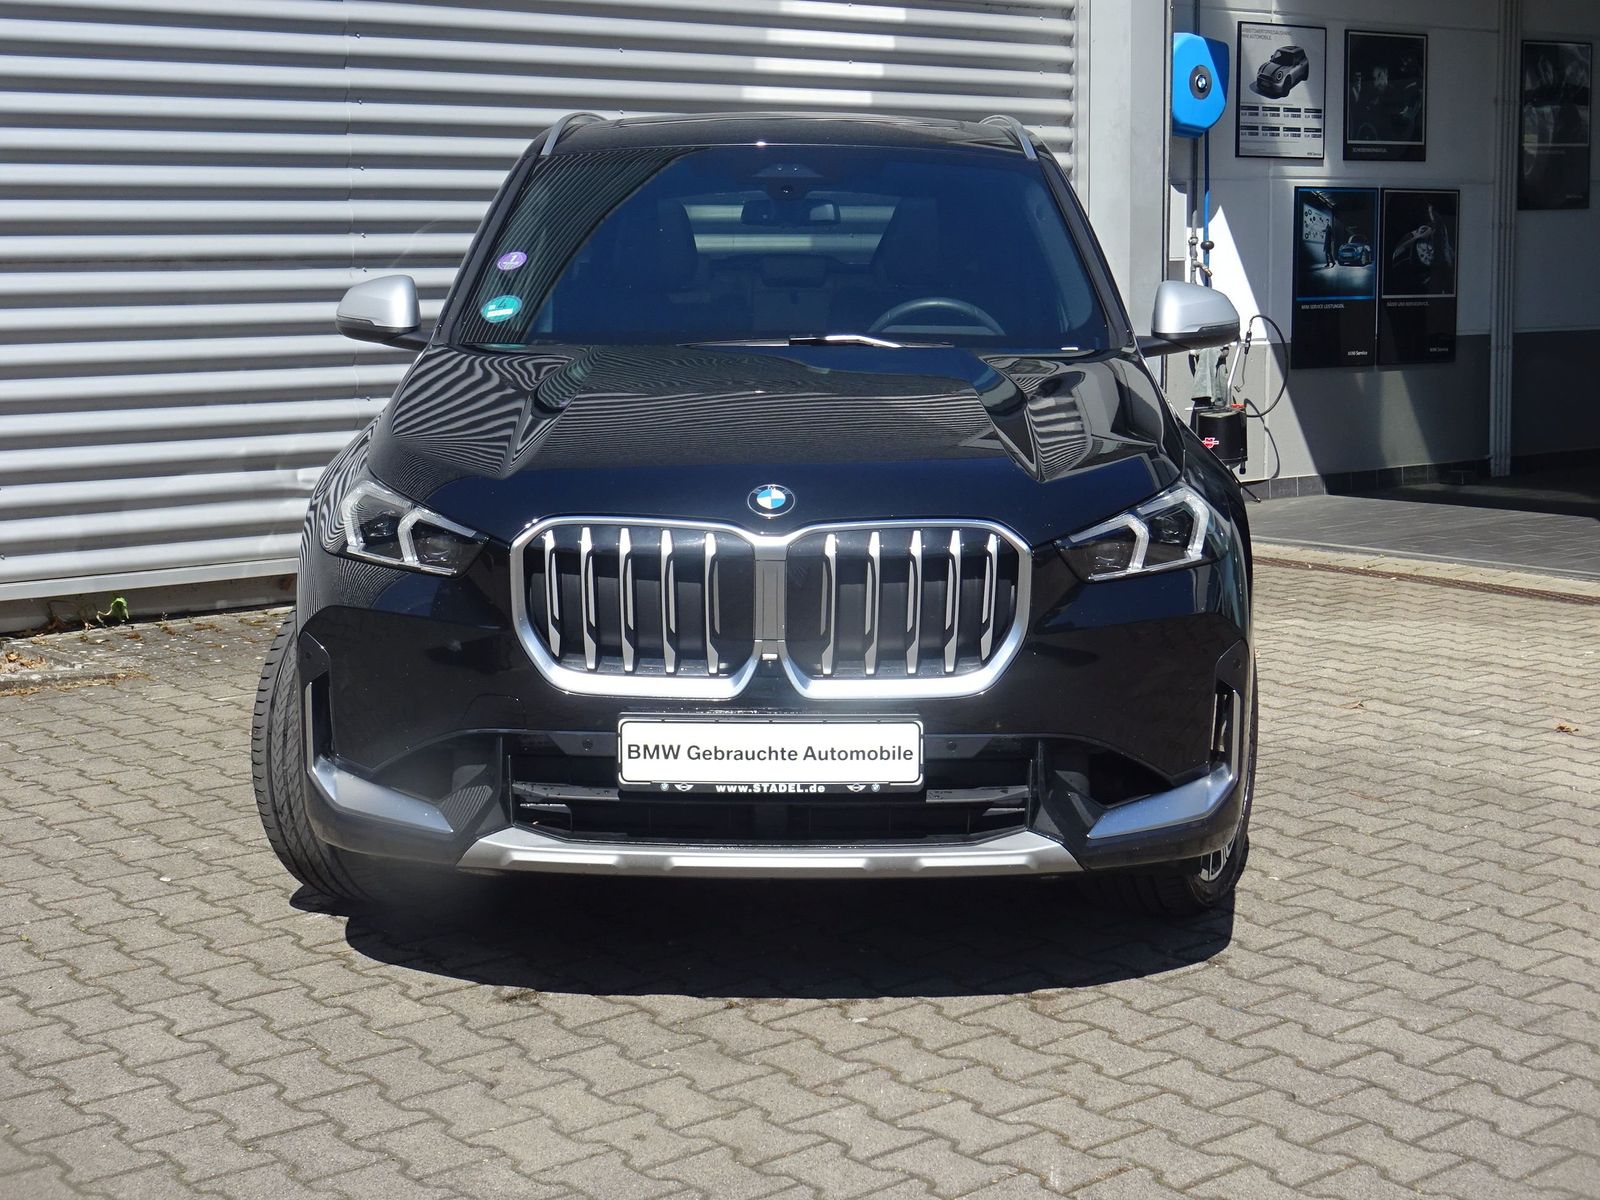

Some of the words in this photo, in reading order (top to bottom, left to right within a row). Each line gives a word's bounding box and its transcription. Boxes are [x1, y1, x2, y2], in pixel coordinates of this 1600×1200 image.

[627, 744, 681, 760] BMW
[687, 745, 798, 761] Gebrauchte
[803, 746, 914, 761] Automobile
[716, 783, 826, 793] www.STADEL.de
